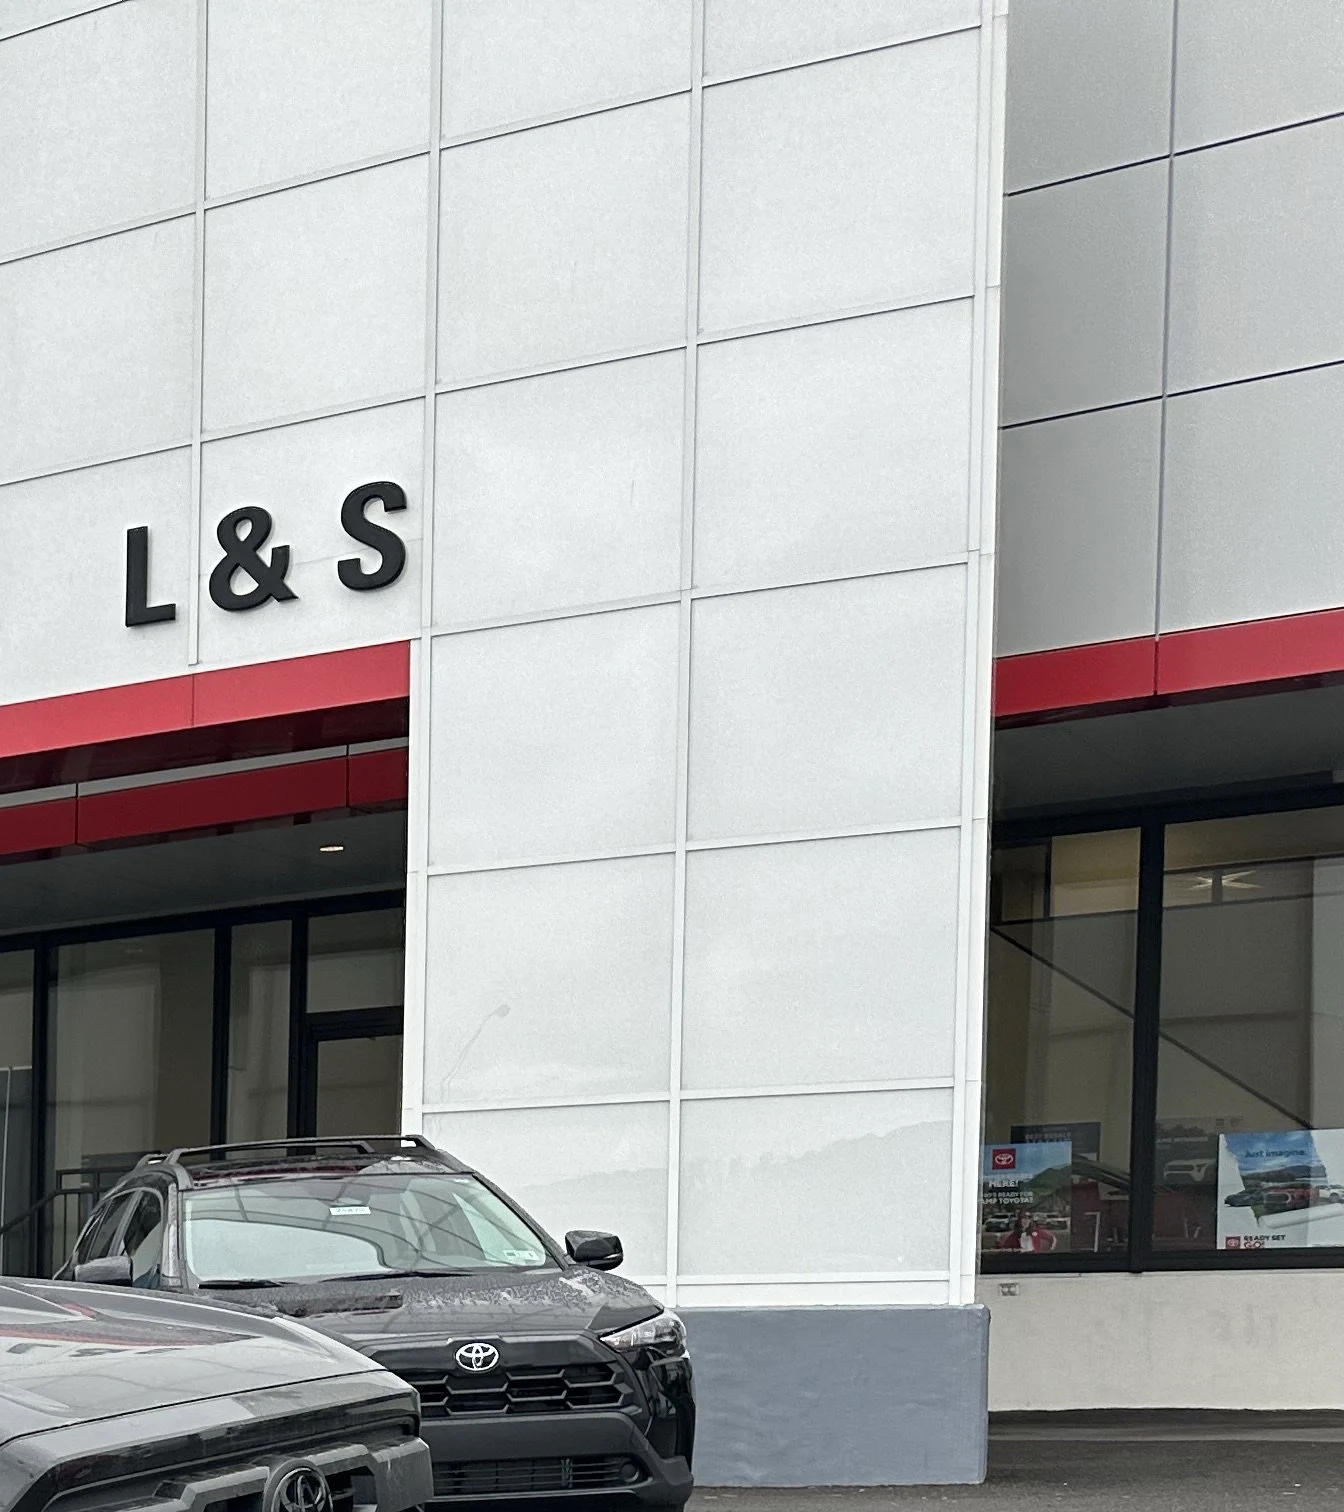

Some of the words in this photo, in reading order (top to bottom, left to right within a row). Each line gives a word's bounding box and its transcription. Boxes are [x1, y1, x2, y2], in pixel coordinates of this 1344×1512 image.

[124, 526, 177, 628] L
[209, 505, 299, 612] &
[337, 480, 408, 591] S
